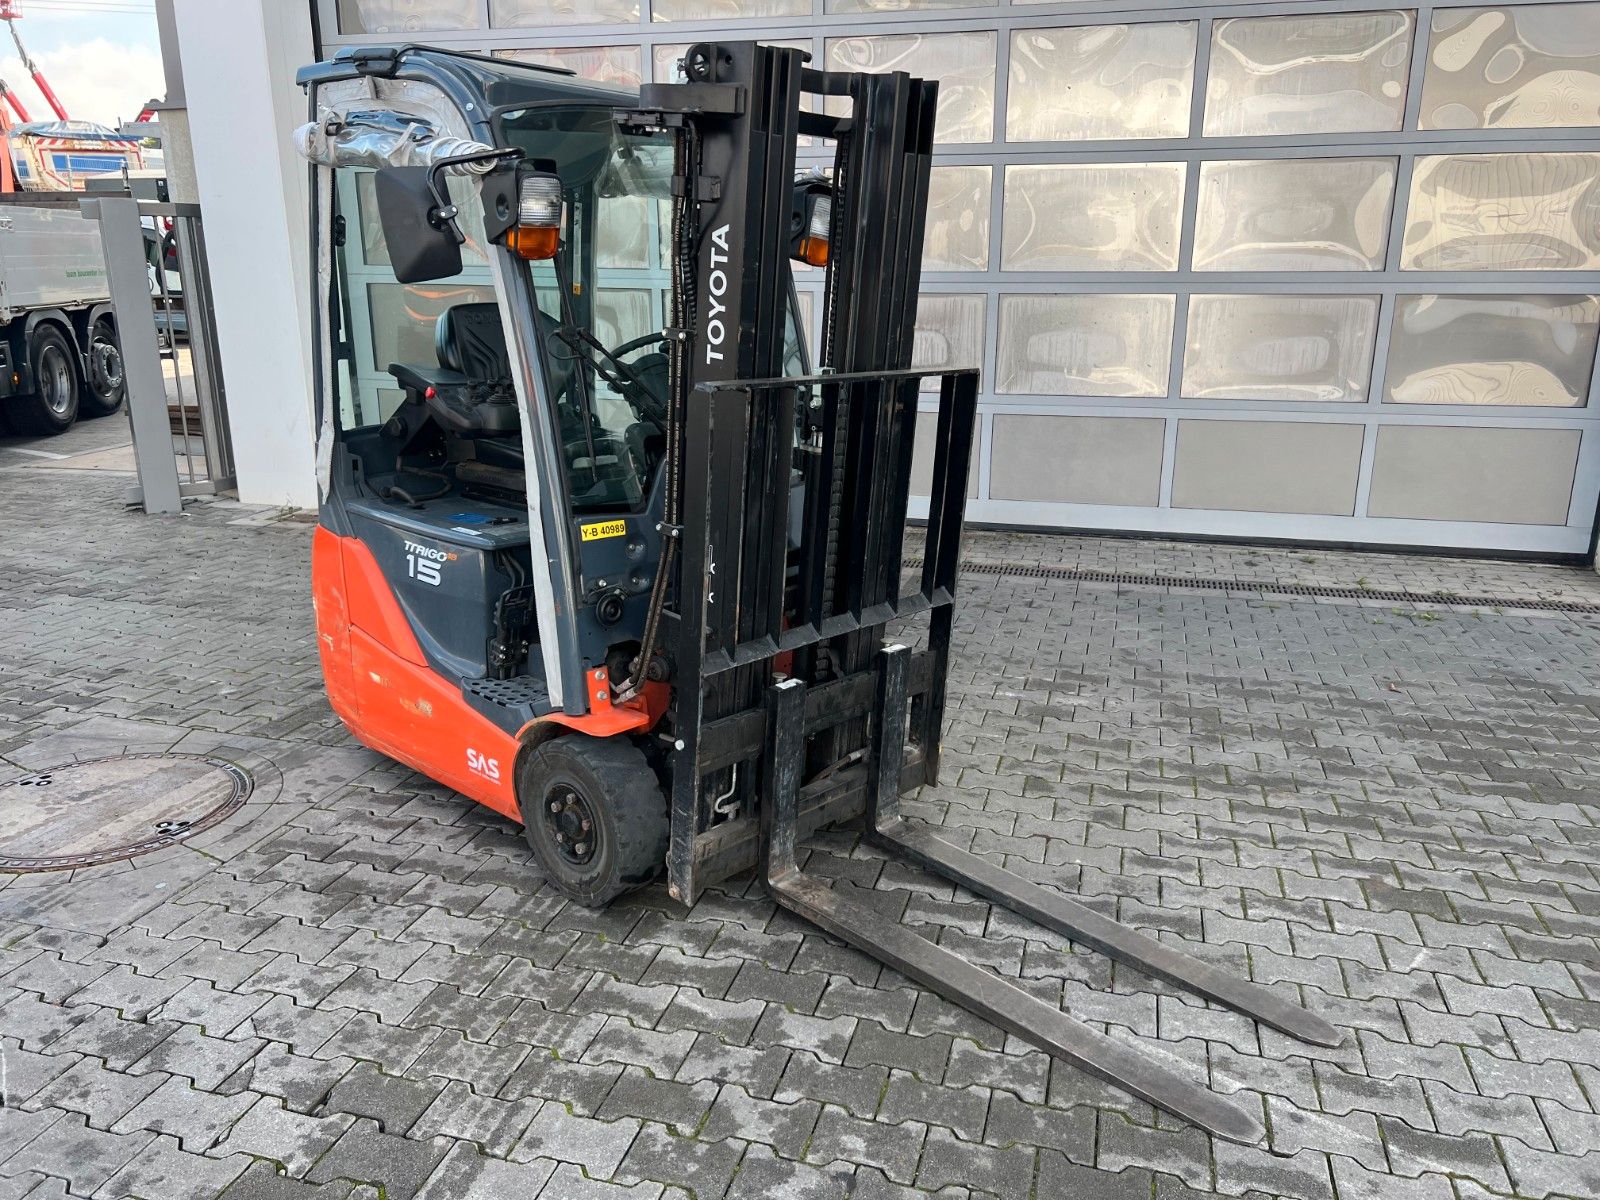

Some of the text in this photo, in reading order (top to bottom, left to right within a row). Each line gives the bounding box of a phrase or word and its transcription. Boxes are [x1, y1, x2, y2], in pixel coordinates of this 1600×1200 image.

[706, 223, 730, 365] TOYOTA
[582, 523, 625, 537] Y-B 40989
[406, 554, 442, 587] 15
[466, 747, 500, 779] SAS
